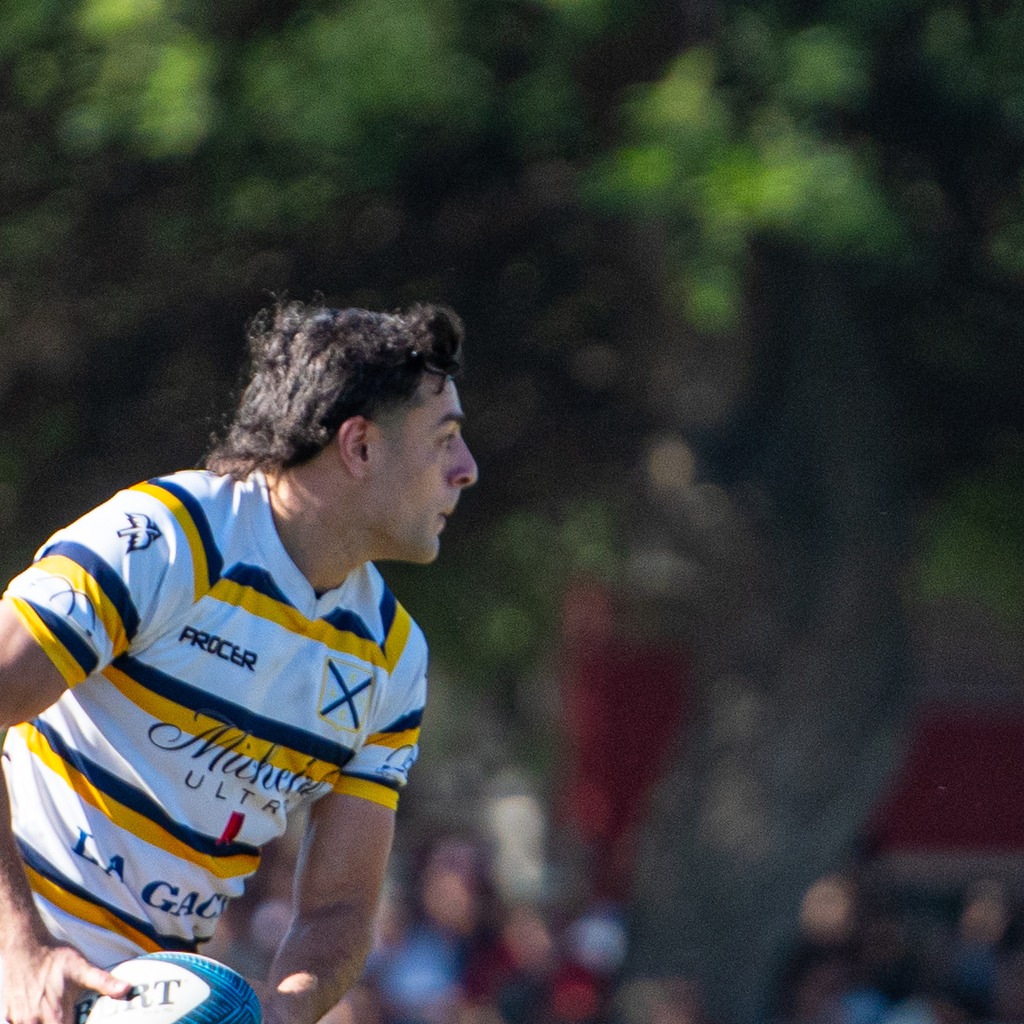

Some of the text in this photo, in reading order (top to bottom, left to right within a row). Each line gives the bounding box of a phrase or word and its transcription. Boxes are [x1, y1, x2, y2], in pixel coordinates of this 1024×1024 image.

[178, 625, 259, 673] PROCER
[184, 769, 289, 816] ULTR
[71, 826, 227, 919] LA GAC
